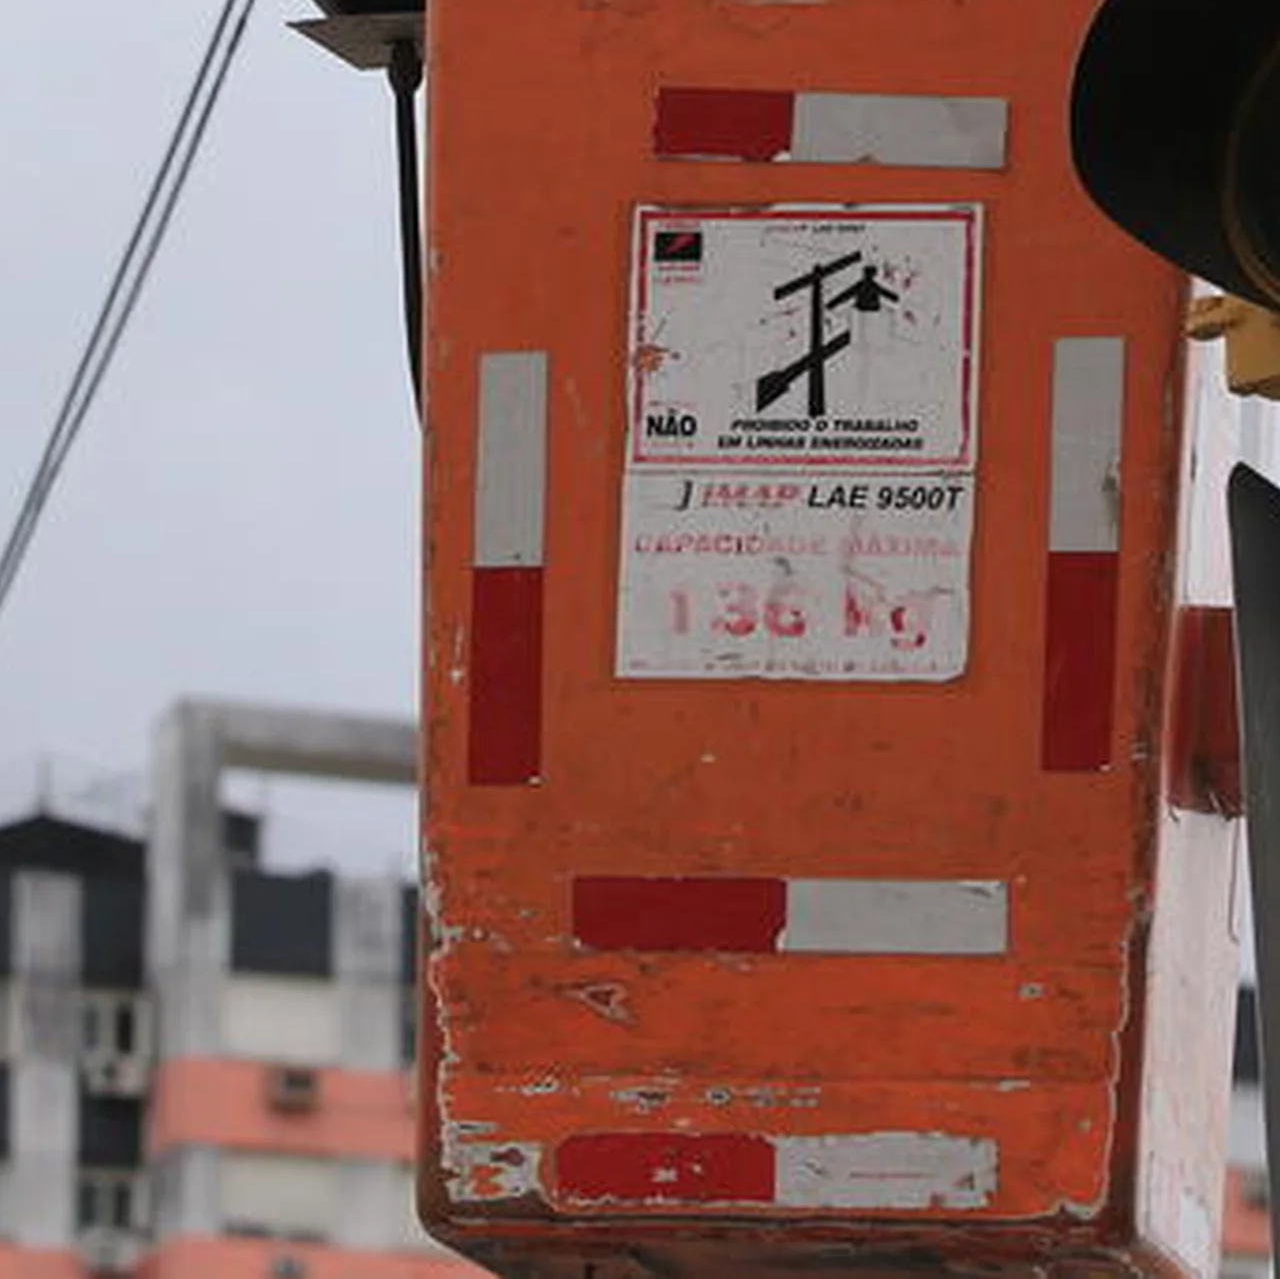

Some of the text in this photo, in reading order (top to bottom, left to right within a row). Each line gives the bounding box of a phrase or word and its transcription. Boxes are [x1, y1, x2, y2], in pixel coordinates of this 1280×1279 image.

[646, 408, 698, 437] NÃO
[814, 419, 828, 432] O
[807, 485, 870, 510] LAE
[875, 485, 965, 511] 9500T
